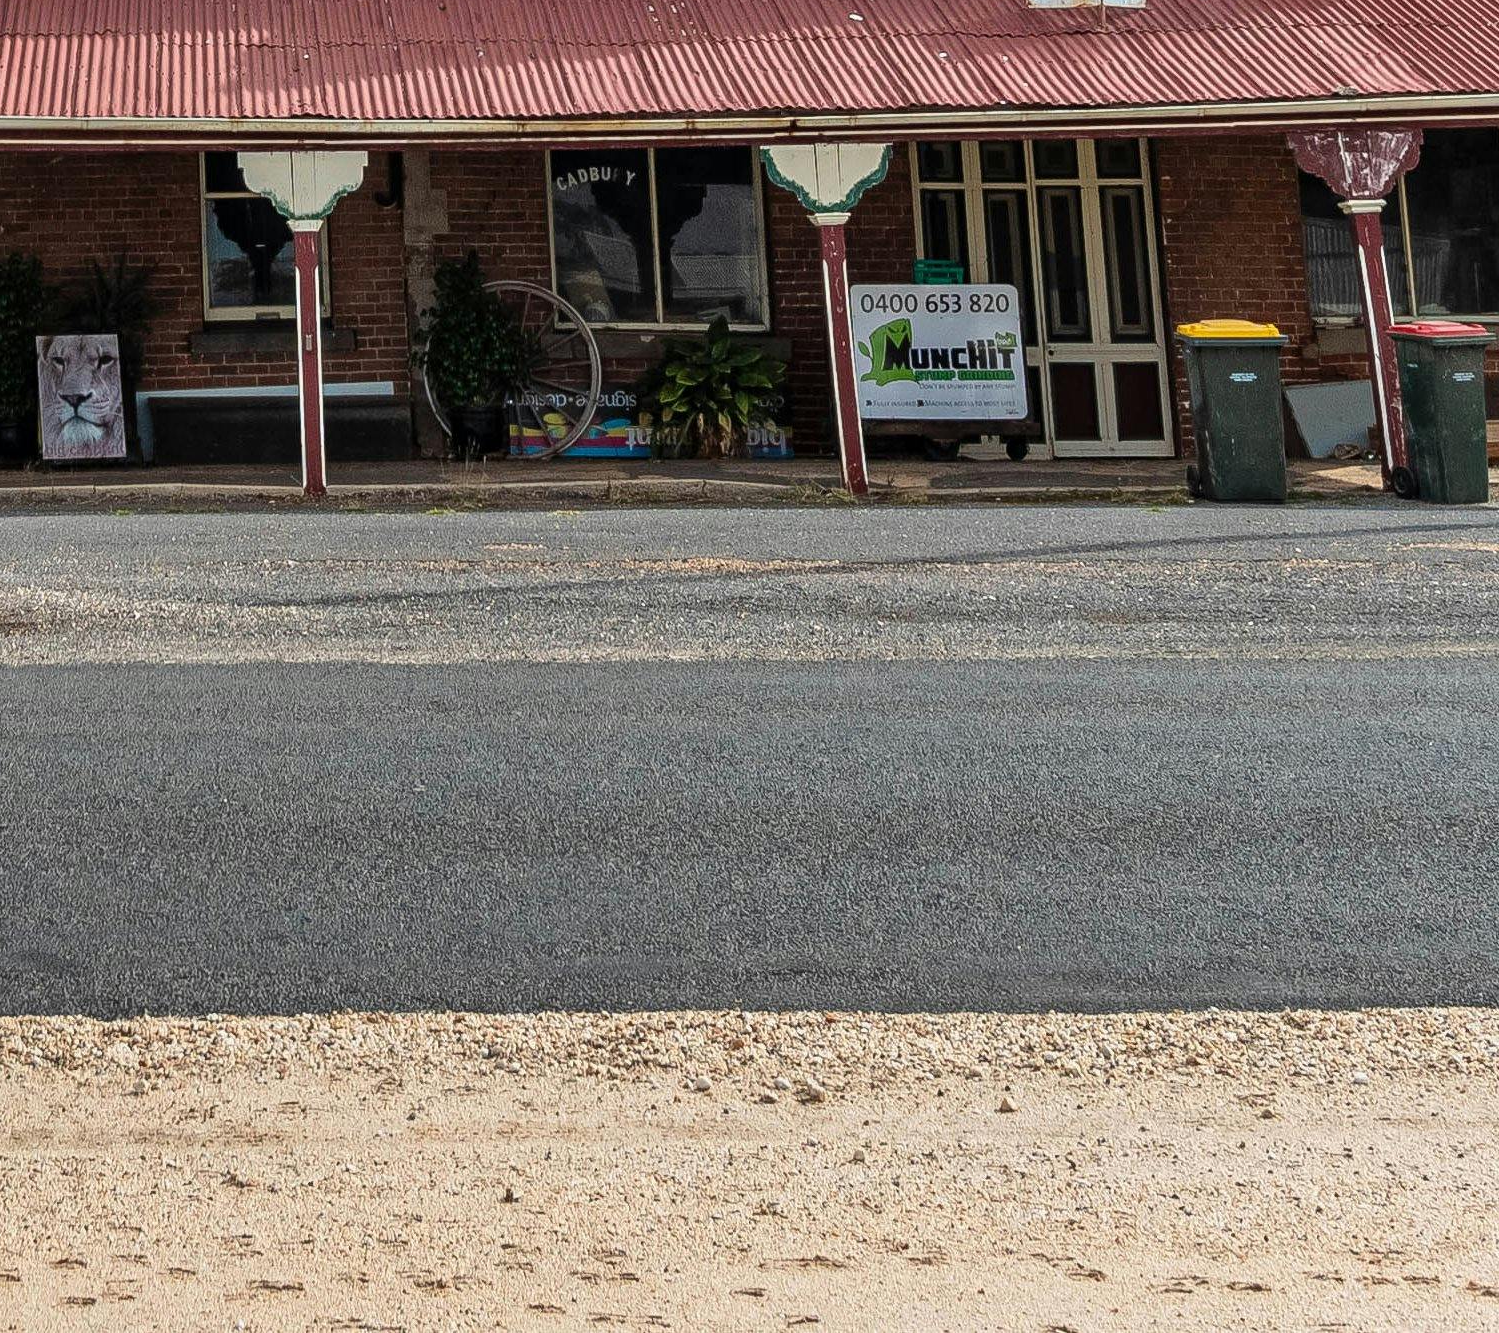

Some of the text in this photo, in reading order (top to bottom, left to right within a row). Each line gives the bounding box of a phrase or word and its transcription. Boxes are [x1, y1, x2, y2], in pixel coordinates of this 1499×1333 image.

[556, 166, 636, 191] CADBUY
[860, 293, 1009, 313] 0400 653 820
